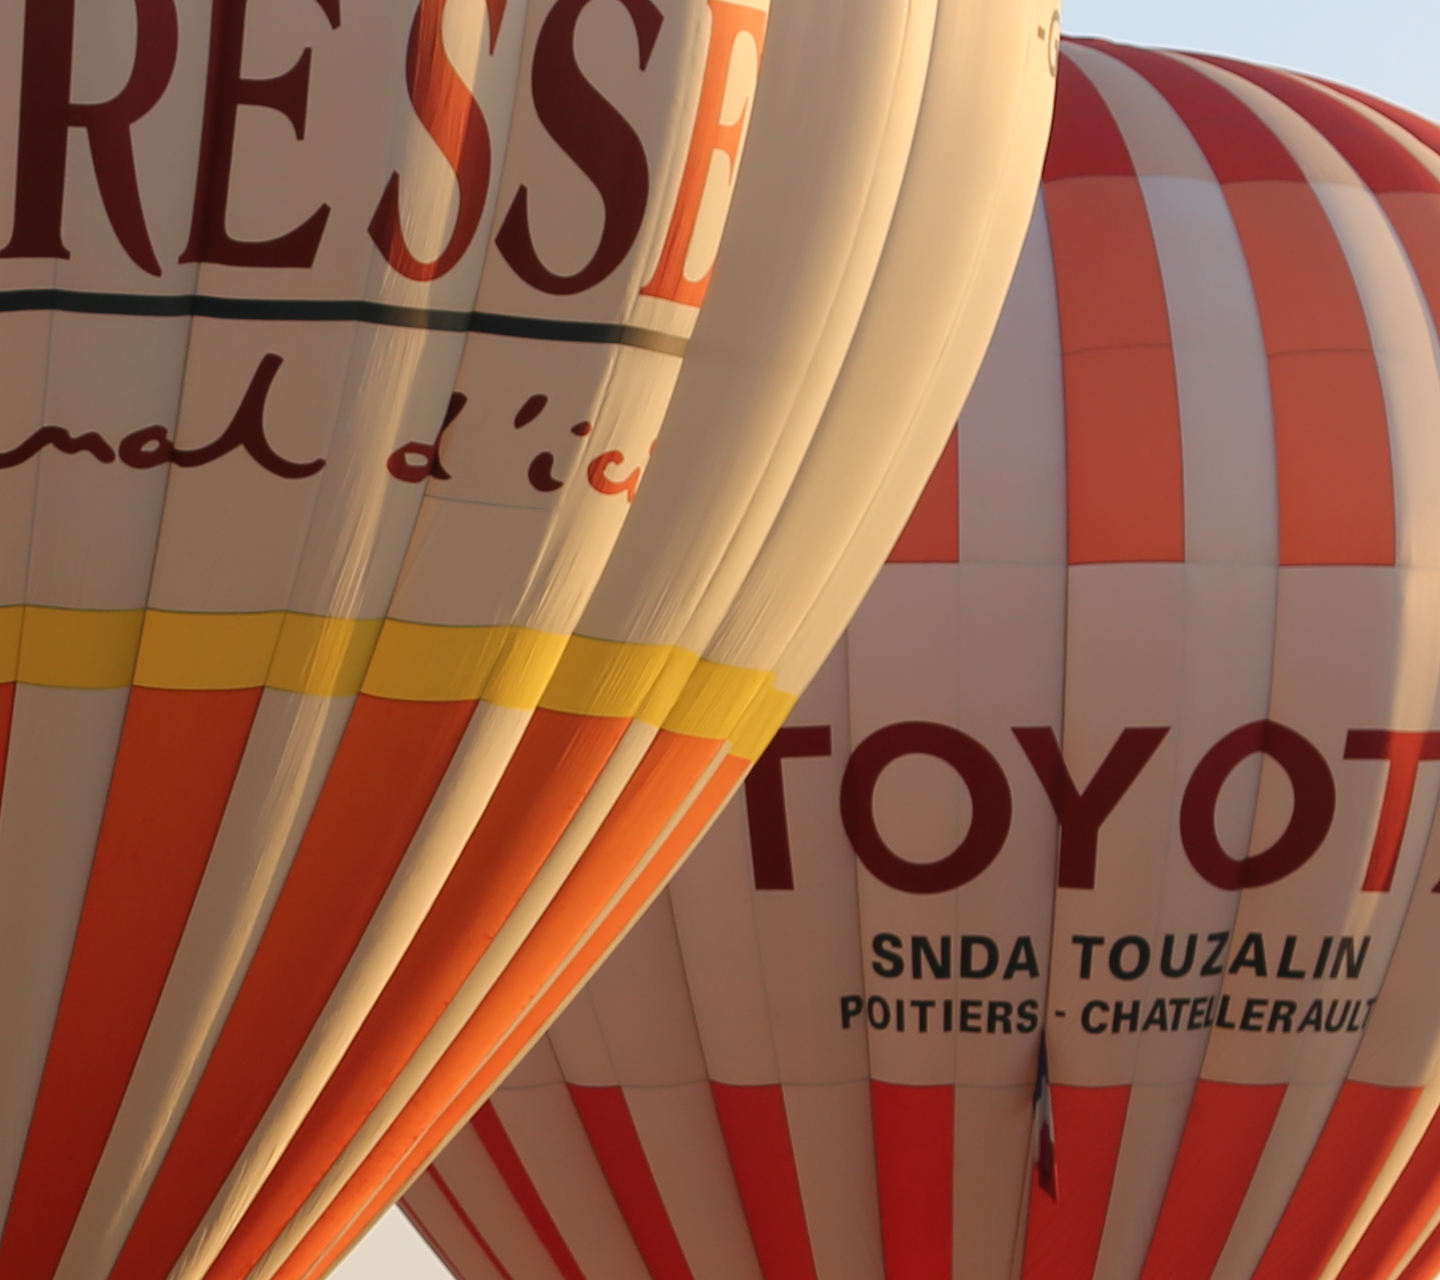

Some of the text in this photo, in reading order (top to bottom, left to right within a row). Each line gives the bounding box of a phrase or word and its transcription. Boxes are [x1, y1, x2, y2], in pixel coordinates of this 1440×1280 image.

[387, 391, 658, 503] d'ic
[870, 931, 1370, 981] SNDA TOUZALIN
[839, 994, 1039, 1035] POITIERS
